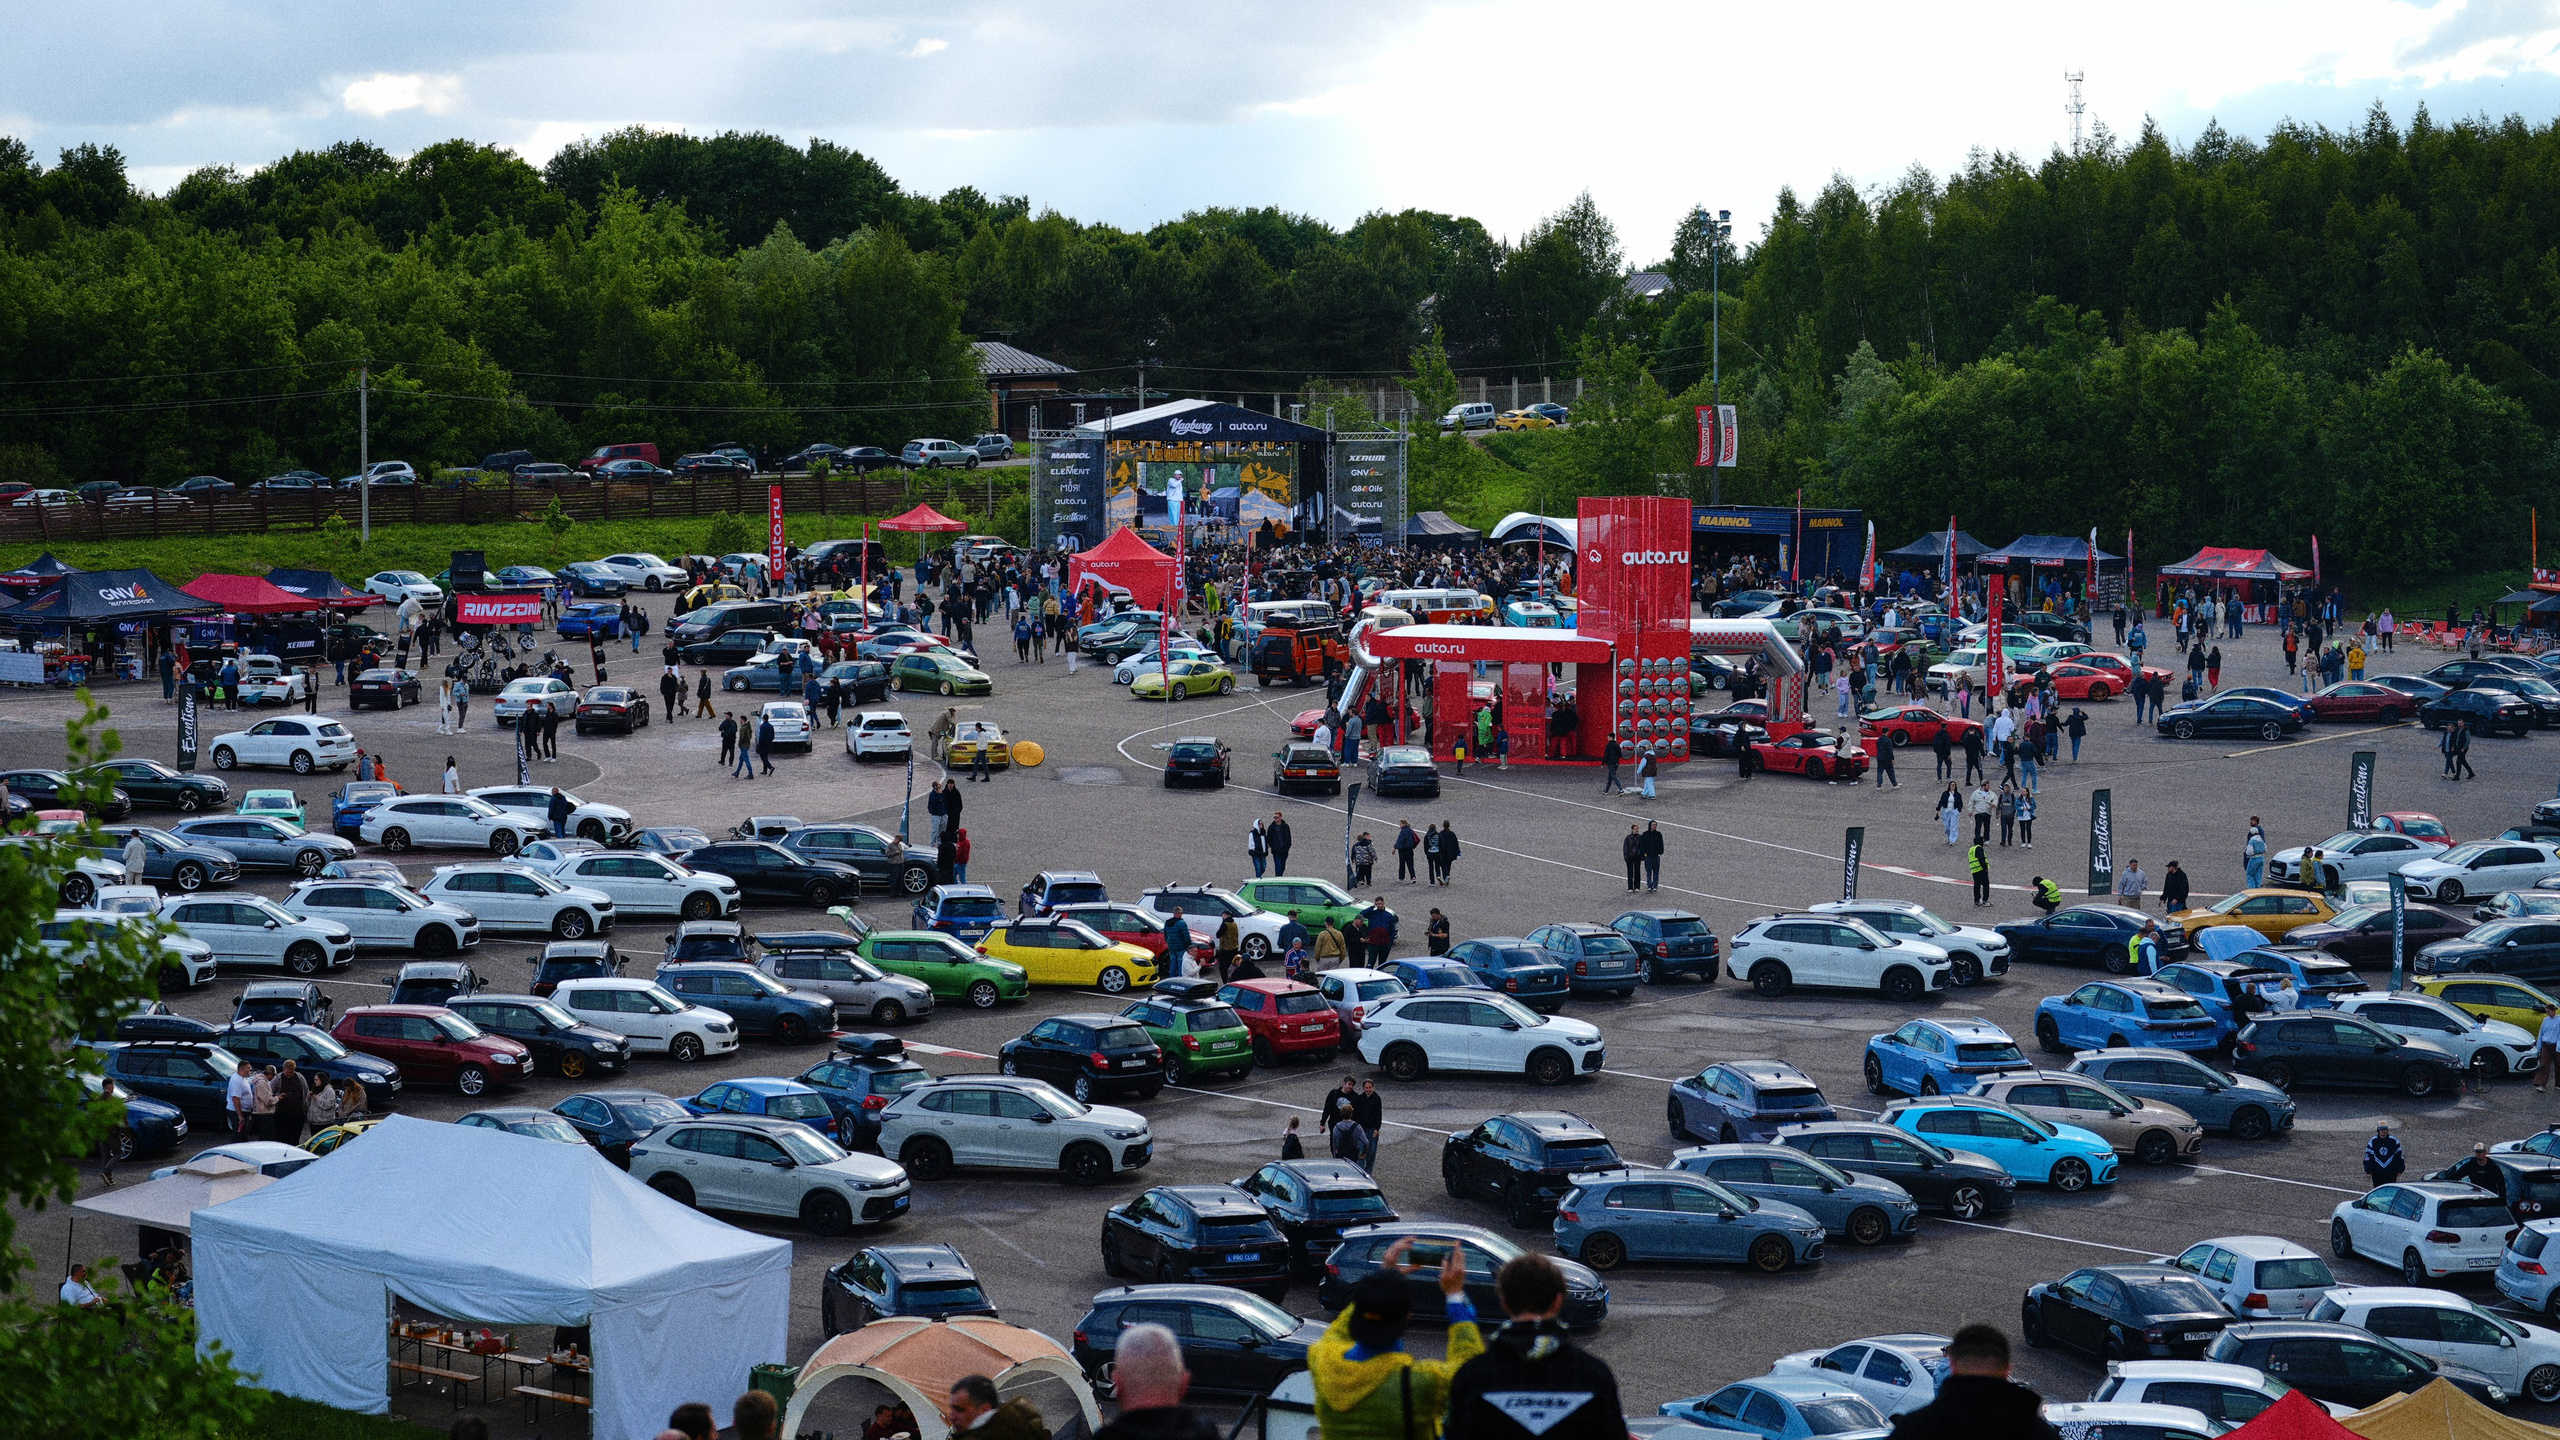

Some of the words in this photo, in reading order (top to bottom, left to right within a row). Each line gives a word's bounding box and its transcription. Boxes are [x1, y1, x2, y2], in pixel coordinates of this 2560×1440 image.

[1169, 417, 1214, 436] Vagburg
[1229, 422, 1267, 431] auto.ru
[878, 522, 899, 530] auto.ru
[1698, 516, 1752, 528] MANNOL
[1808, 517, 1844, 528] MANNOL
[771, 498, 782, 571] auto.ru
[1621, 550, 1689, 565] auto.ru
[99, 586, 135, 601] GNV
[118, 622, 135, 632] GNV
[286, 640, 316, 649] XENUM
[1414, 642, 1465, 655] auto.ru
[181, 693, 196, 753] Eventism
[2352, 762, 2369, 829] Eventism
[2093, 801, 2112, 873] Eventism
